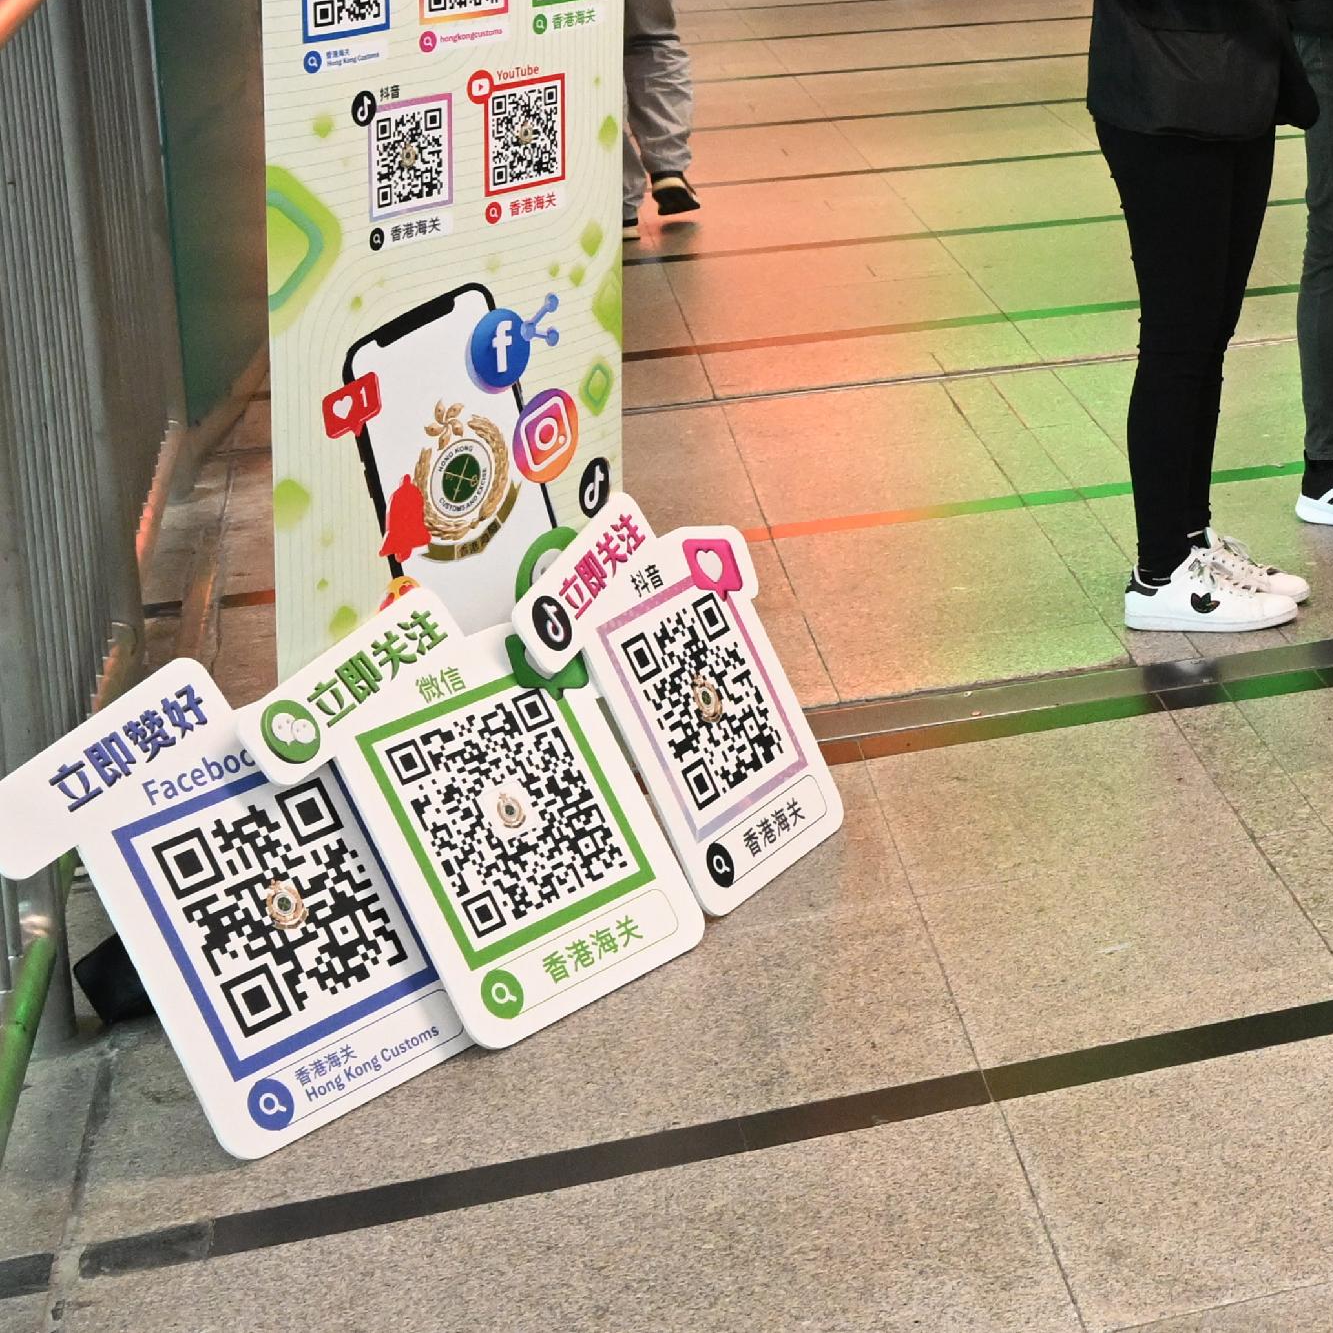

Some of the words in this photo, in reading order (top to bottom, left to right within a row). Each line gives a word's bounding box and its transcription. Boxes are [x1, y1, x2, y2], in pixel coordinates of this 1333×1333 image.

[440, 28, 503, 43] hongkongcustoms
[552, 9, 596, 30] 香港海关
[496, 64, 540, 80] YouTube
[379, 84, 400, 101] 抖音
[509, 194, 557, 217] 香港海关
[390, 216, 441, 243] 香港海关
[559, 514, 646, 620] 立即关注
[630, 564, 664, 597] 抖音
[307, 610, 449, 728] 立即关注
[415, 666, 466, 704] 微信
[142, 748, 256, 806] Faceboo
[742, 800, 806, 859] 香港海关
[541, 914, 645, 986] 香港海关
[295, 1044, 358, 1087] 香港海关
[305, 1075, 346, 1102] Hong
[344, 1054, 382, 1081] Kong
[380, 1026, 440, 1063] Customs
